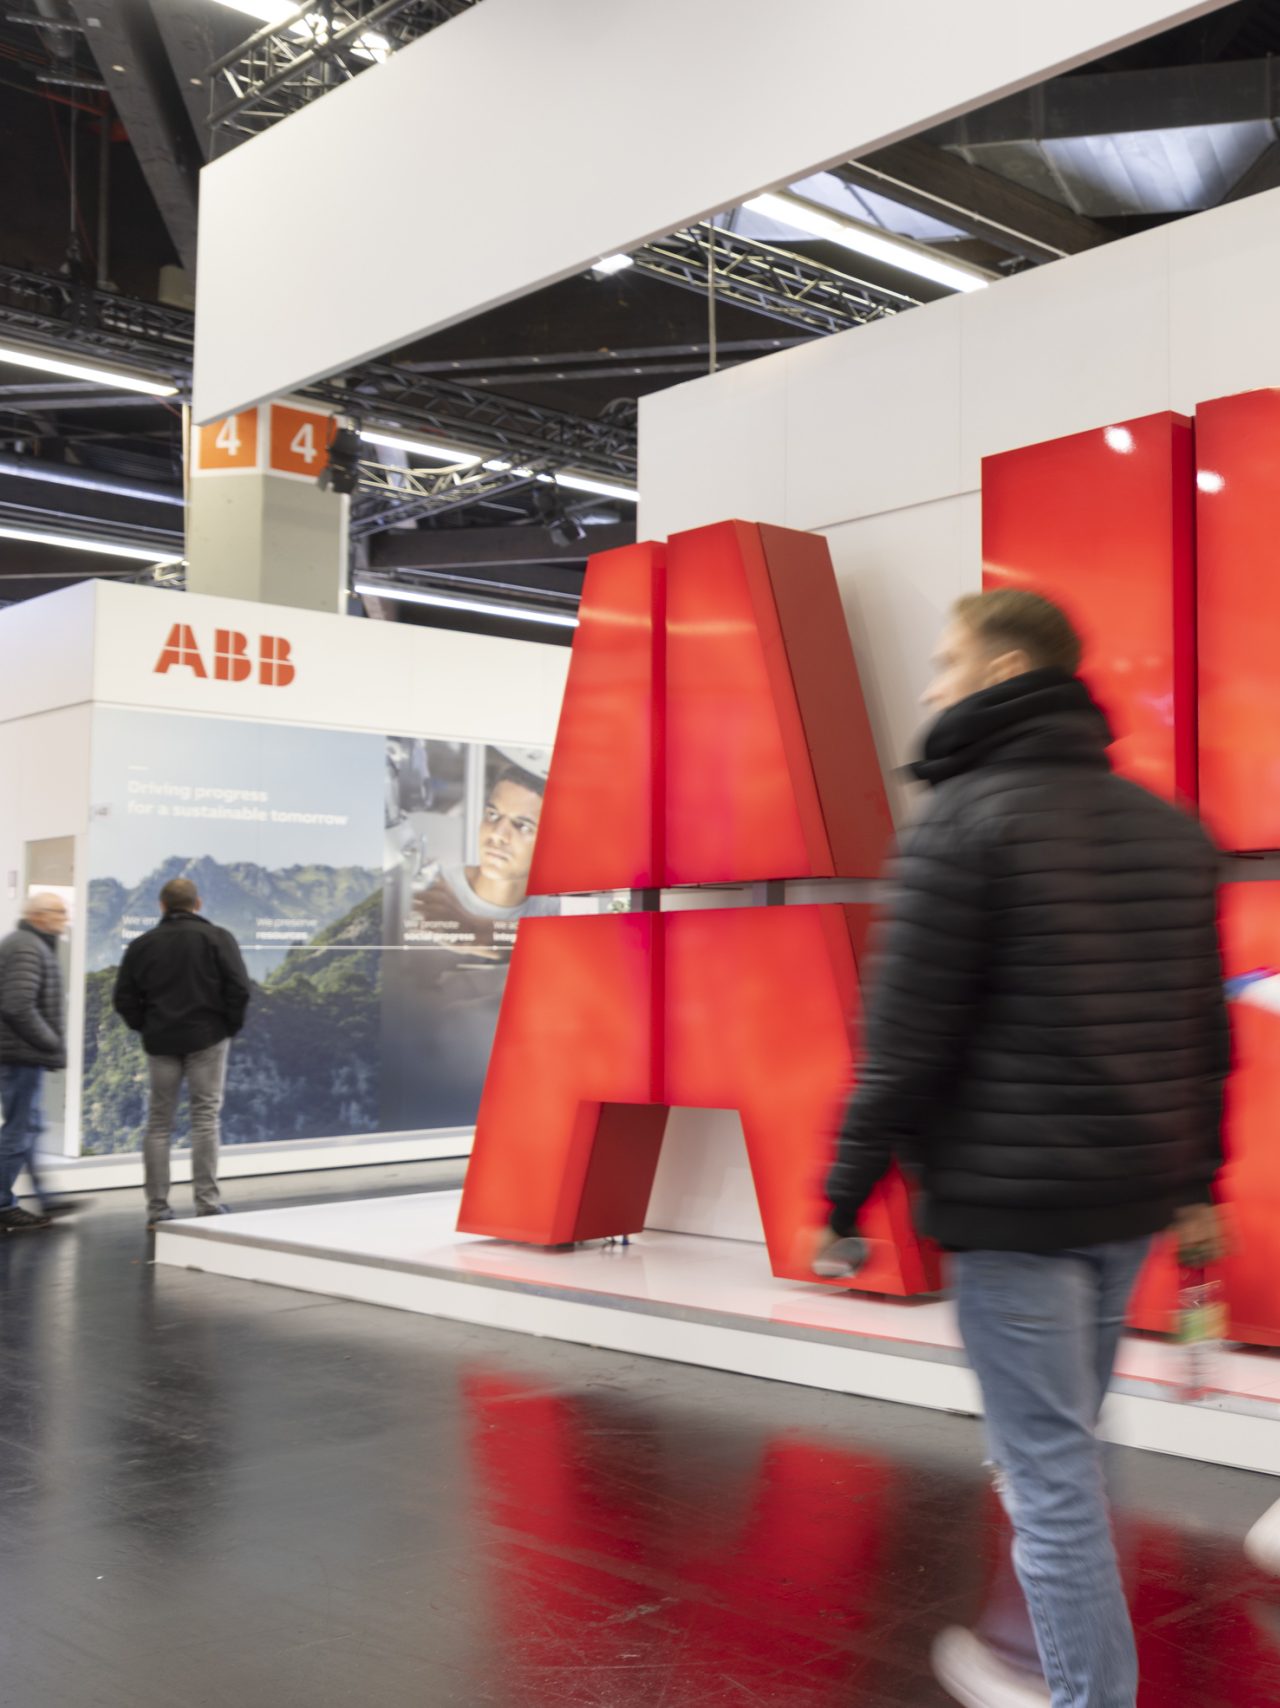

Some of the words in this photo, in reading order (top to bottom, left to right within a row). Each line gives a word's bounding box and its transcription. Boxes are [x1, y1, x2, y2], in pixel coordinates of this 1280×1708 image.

[215, 415, 240, 456] 4
[290, 422, 317, 464] 4
[153, 622, 296, 687] ABB
[128, 780, 192, 800] Driving
[194, 786, 268, 803] progress
[128, 799, 153, 815] for
[157, 804, 169, 815] a
[172, 804, 268, 822] sustainable
[271, 809, 348, 826] tomorrow
